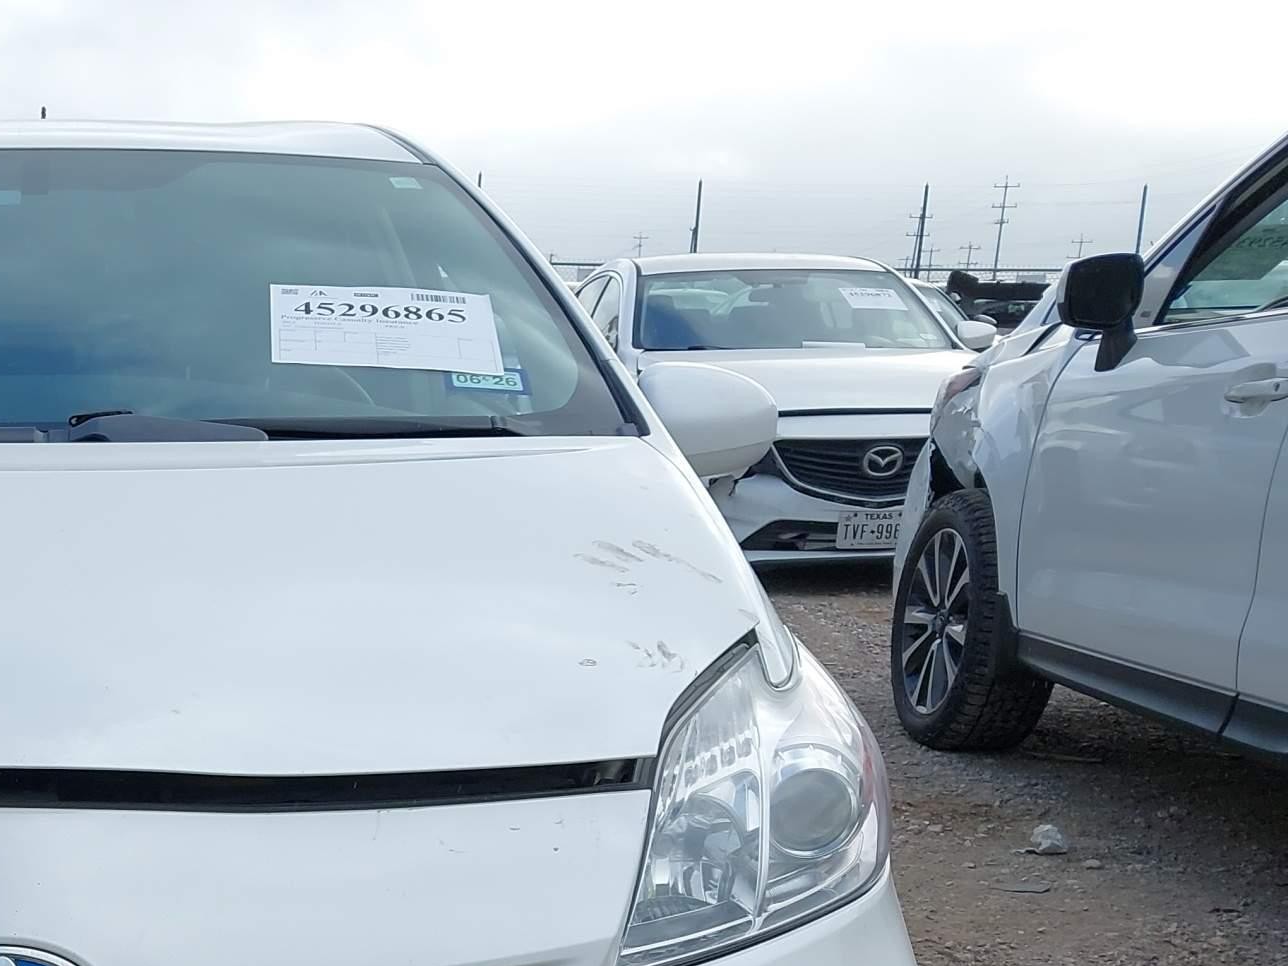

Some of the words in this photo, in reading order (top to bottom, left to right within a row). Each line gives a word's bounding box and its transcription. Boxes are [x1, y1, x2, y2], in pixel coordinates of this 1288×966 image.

[294, 301, 467, 324] 45296865
[456, 374, 482, 385] 06
[492, 375, 518, 387] 26
[864, 512, 894, 521] TEXAS
